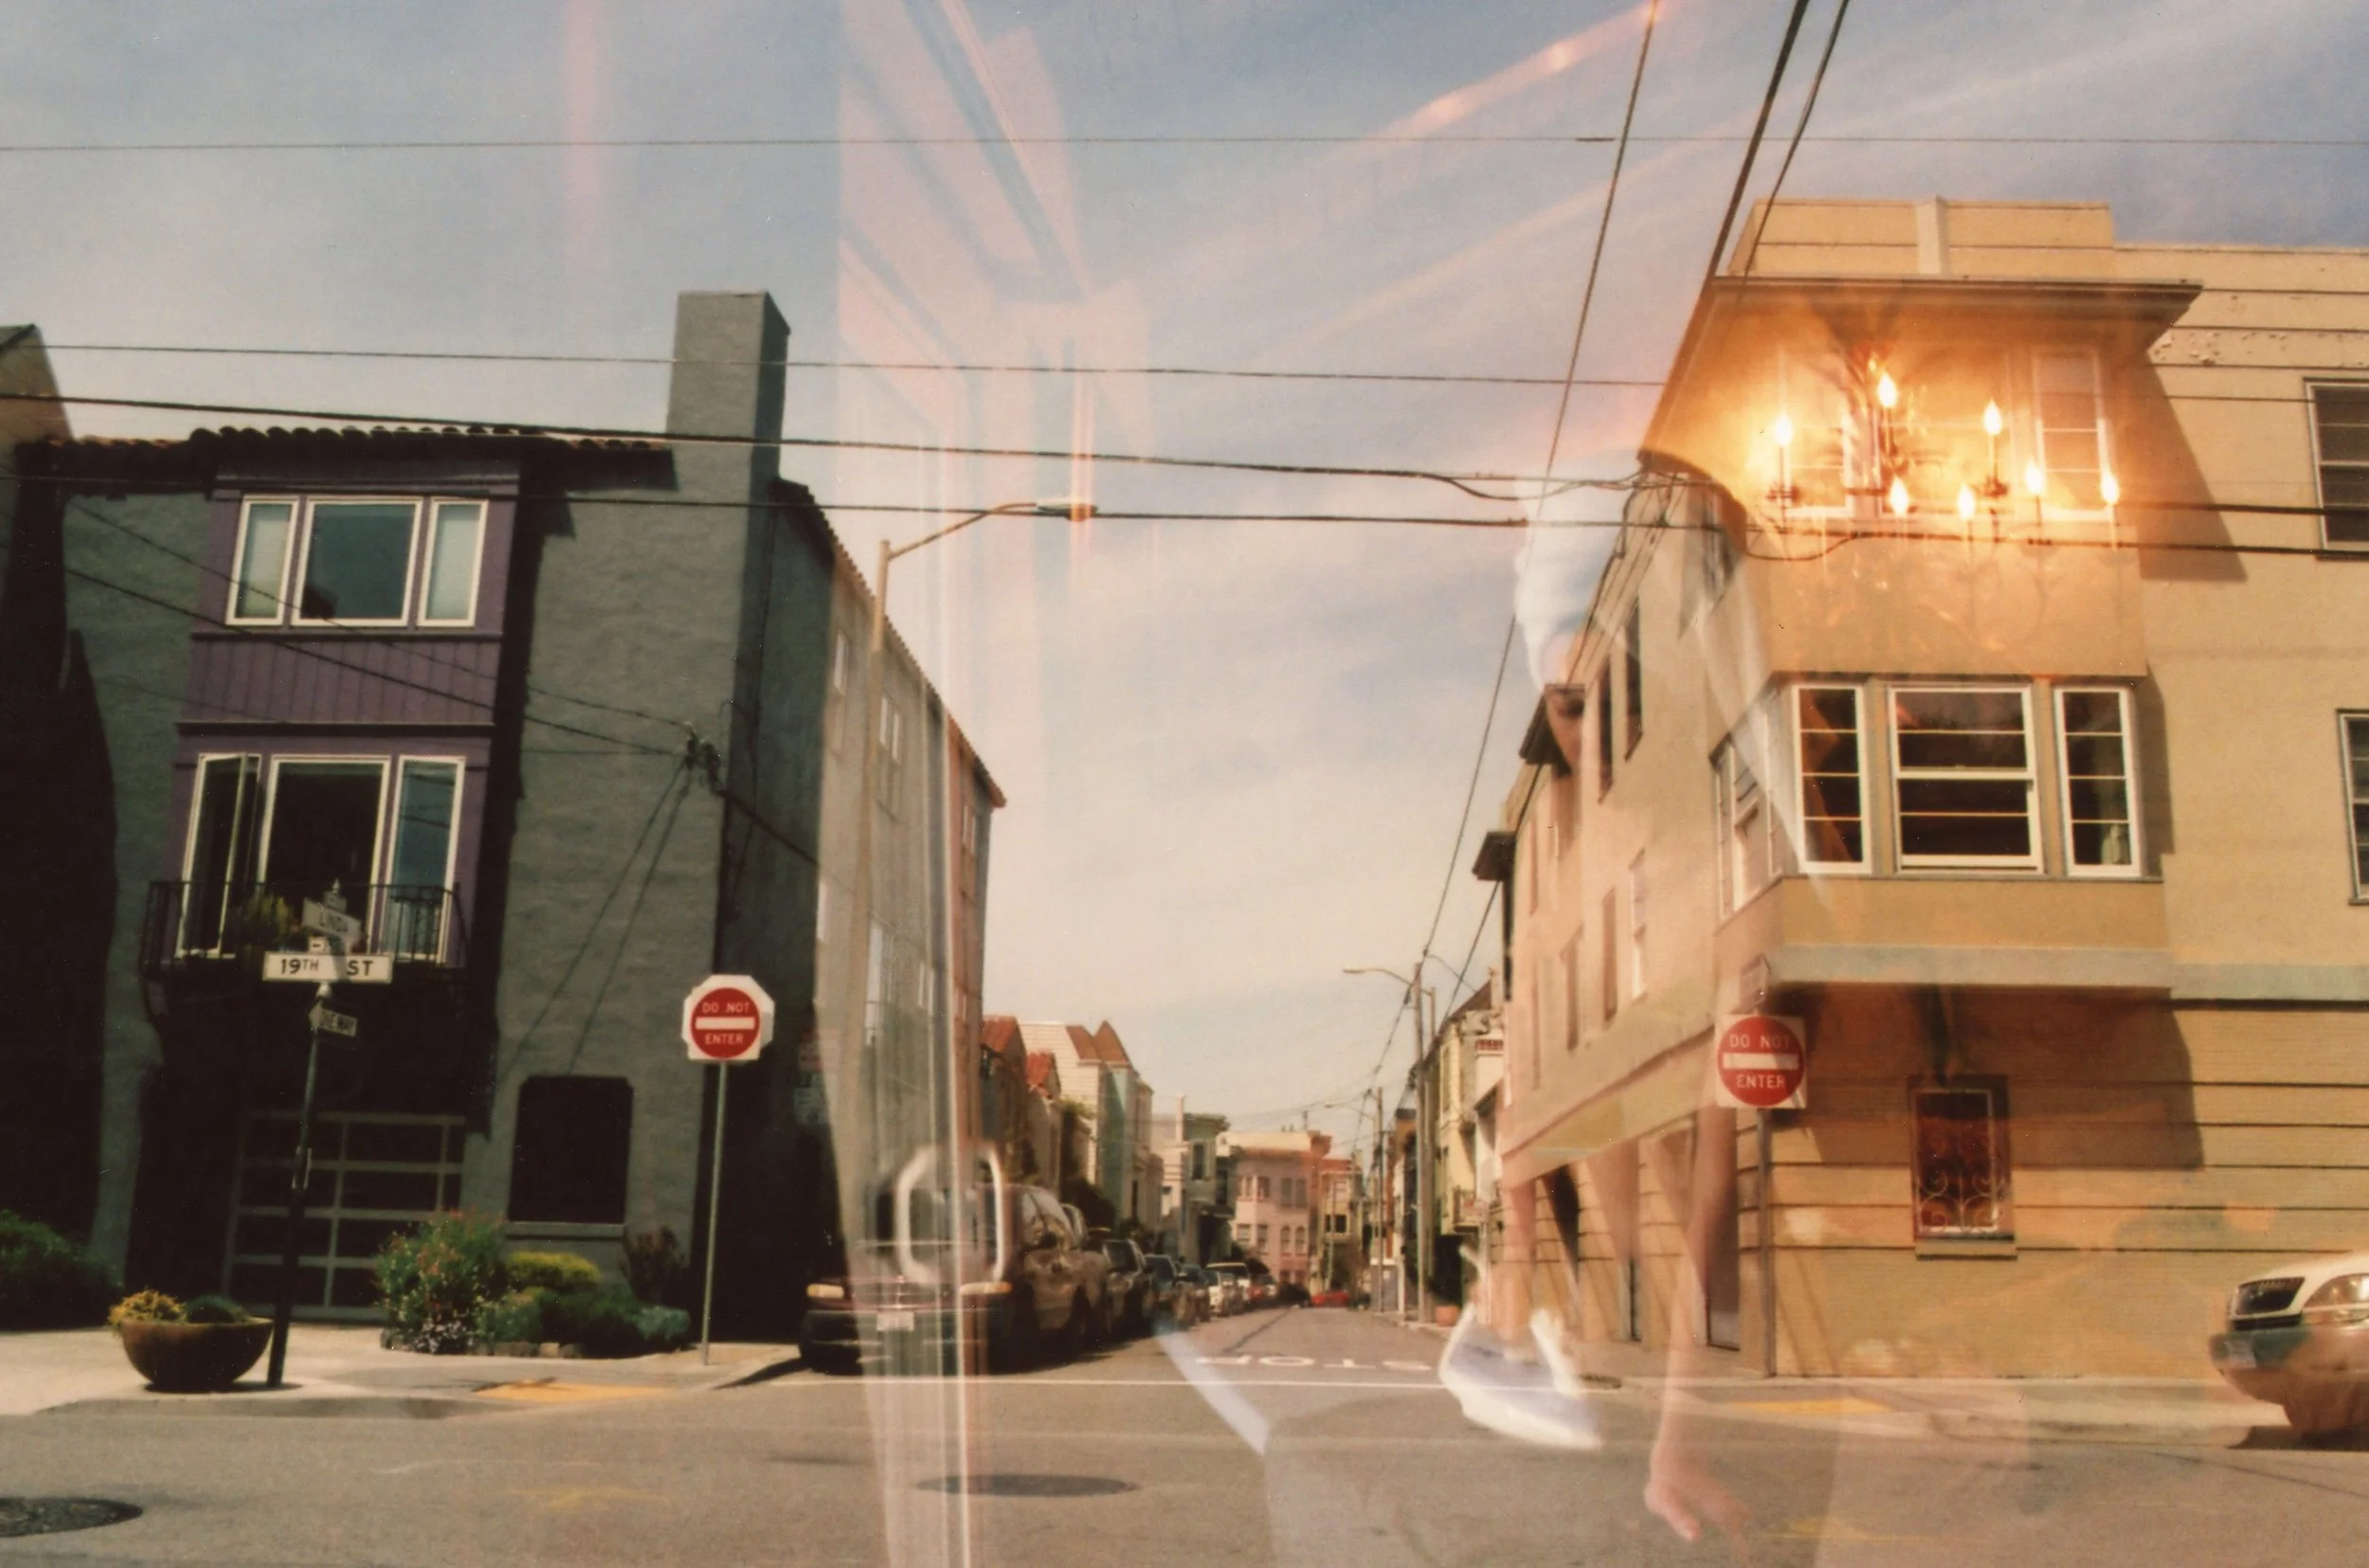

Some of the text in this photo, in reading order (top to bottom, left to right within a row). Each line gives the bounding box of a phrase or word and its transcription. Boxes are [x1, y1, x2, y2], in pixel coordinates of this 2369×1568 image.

[280, 958, 373, 976] 19TH ST
[702, 1002, 750, 1014] DO NOT
[705, 1033, 744, 1044] ENTER
[1729, 1034, 1789, 1049] DO NOT
[1736, 1073, 1785, 1089] ENTER
